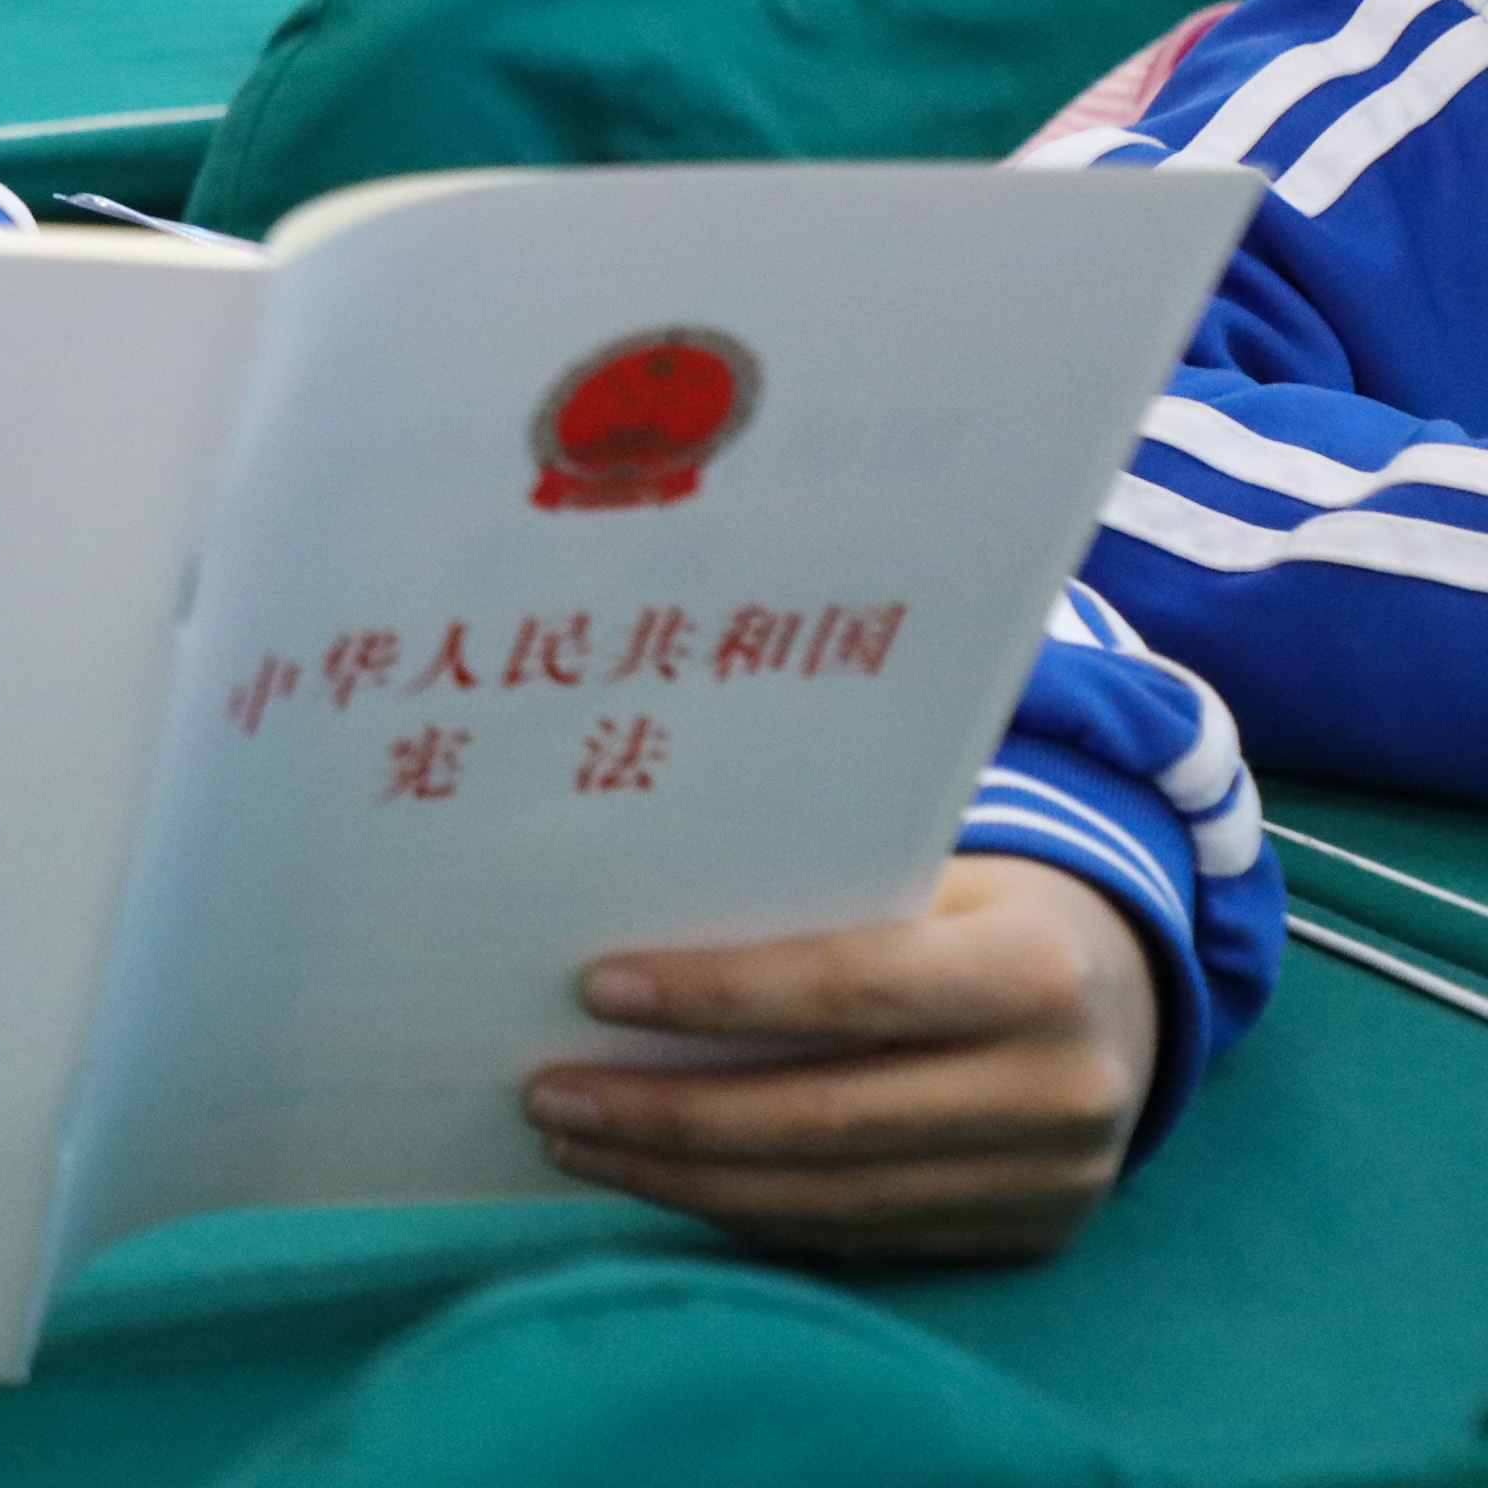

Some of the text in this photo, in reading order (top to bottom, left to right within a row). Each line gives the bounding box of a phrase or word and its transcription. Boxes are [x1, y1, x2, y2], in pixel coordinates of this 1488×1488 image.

[227, 602, 910, 736] 中华人民共和国
[378, 715, 670, 802] 宪 法
